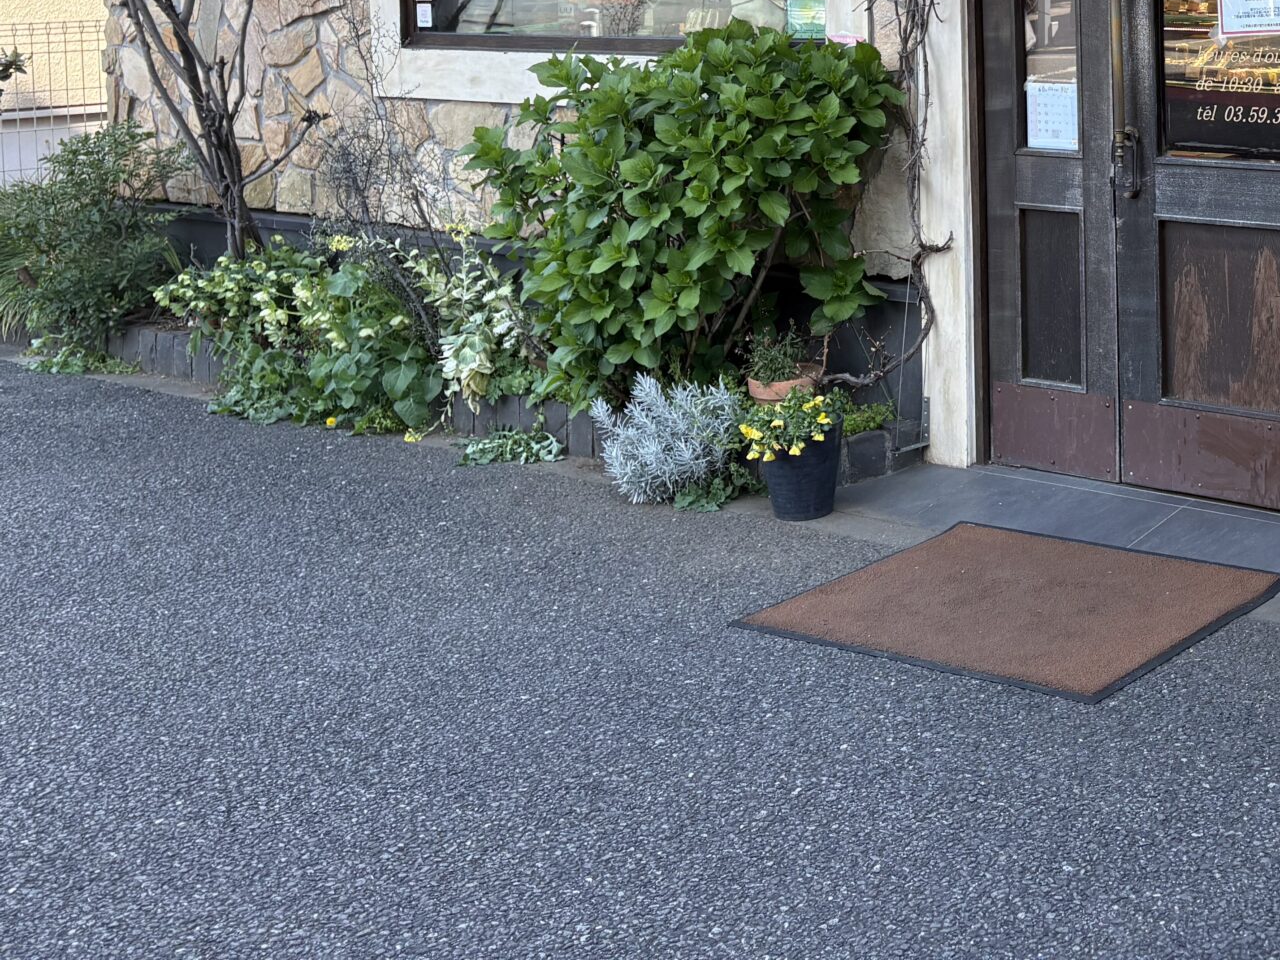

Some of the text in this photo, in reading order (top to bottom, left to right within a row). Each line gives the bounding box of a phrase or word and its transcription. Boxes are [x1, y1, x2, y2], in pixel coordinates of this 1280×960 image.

[1195, 74, 1213, 91] de
[1221, 77, 1263, 93] 10:30
[1196, 105, 1217, 121] tél
